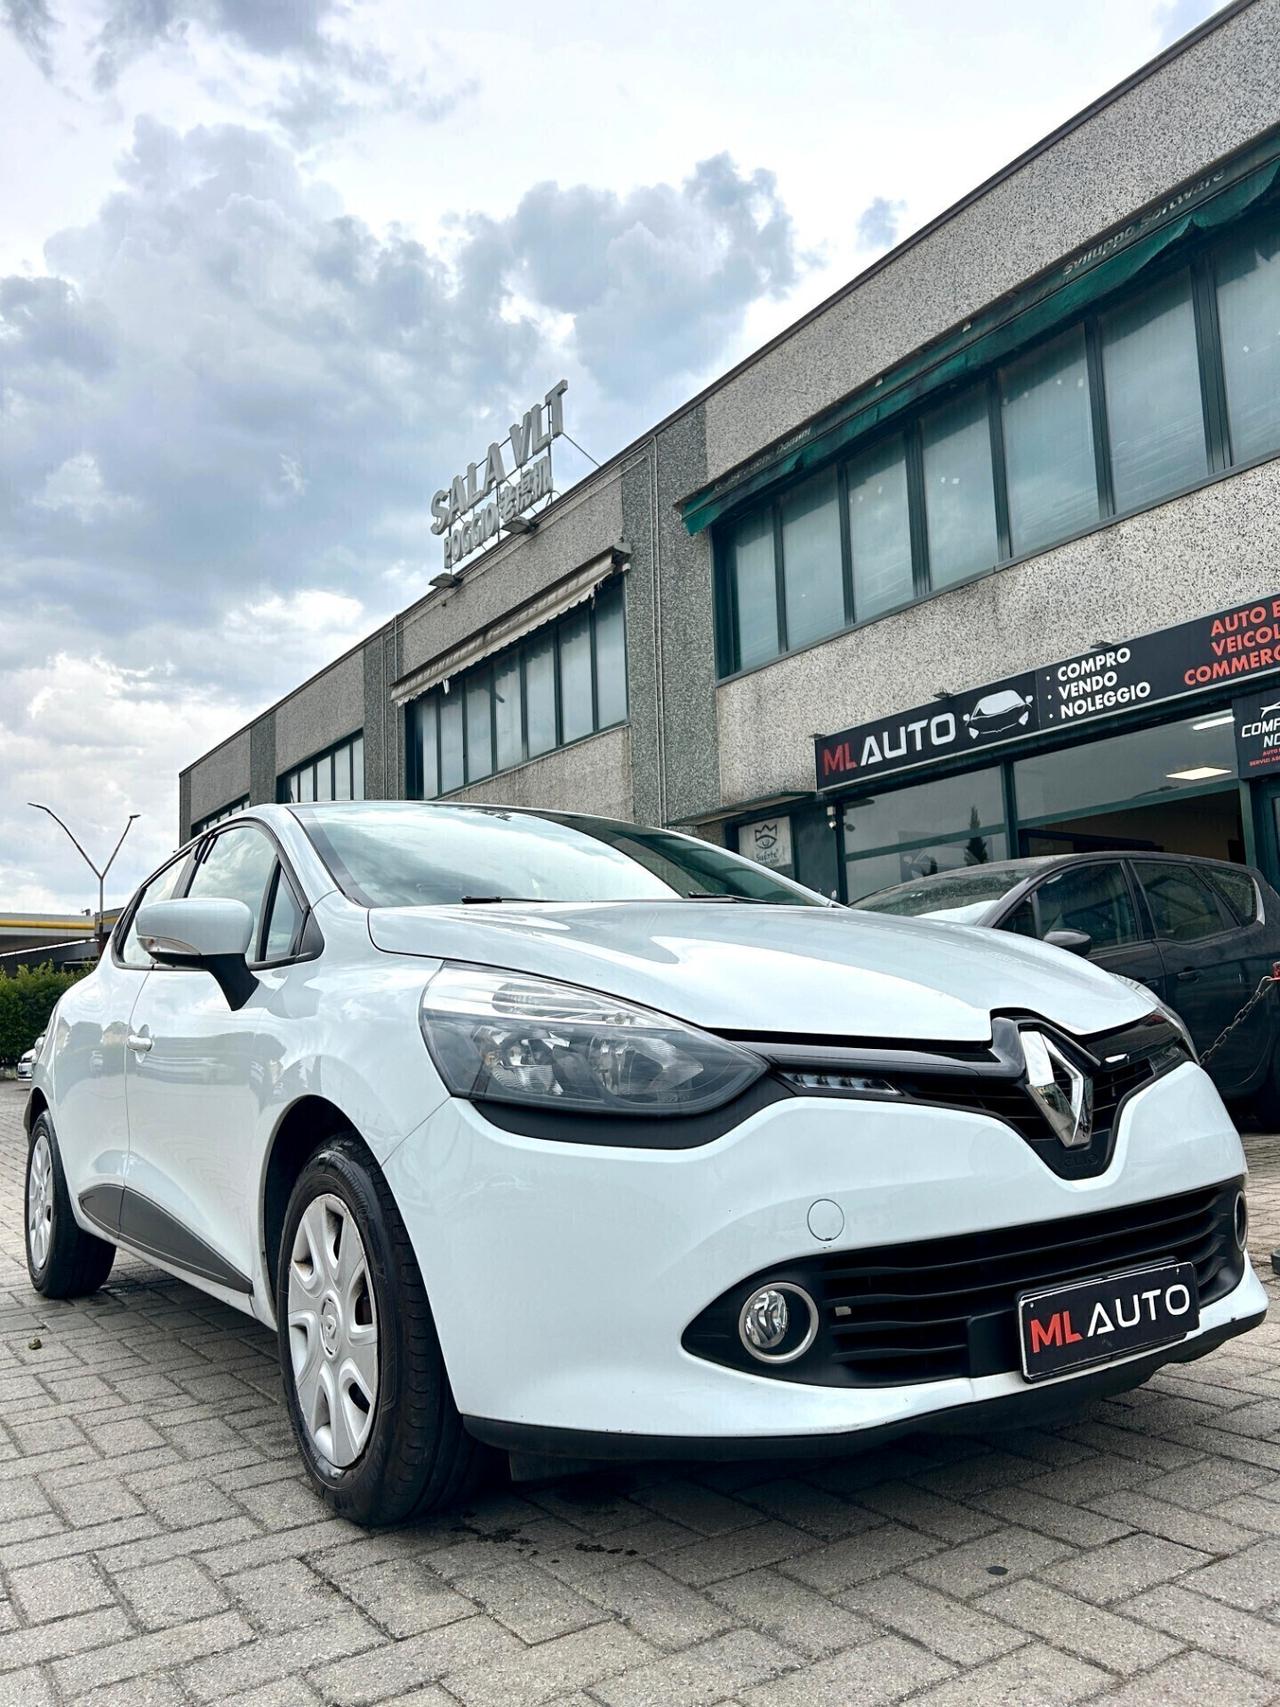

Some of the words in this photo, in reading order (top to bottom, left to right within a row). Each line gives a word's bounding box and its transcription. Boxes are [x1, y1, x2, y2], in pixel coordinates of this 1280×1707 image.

[430, 442, 506, 536] SALA
[509, 379, 569, 469] VLT
[1211, 606, 1267, 637] AUTO
[1211, 623, 1280, 656] VEICOL
[1057, 647, 1131, 681] COMPRO
[1058, 671, 1118, 700] VENDO
[1060, 681, 1151, 719] NOLEGGIO
[823, 742, 857, 776] ML
[860, 712, 956, 766] AUTO
[1030, 1310, 1083, 1354] ML
[1087, 1283, 1190, 1338] AUTO
